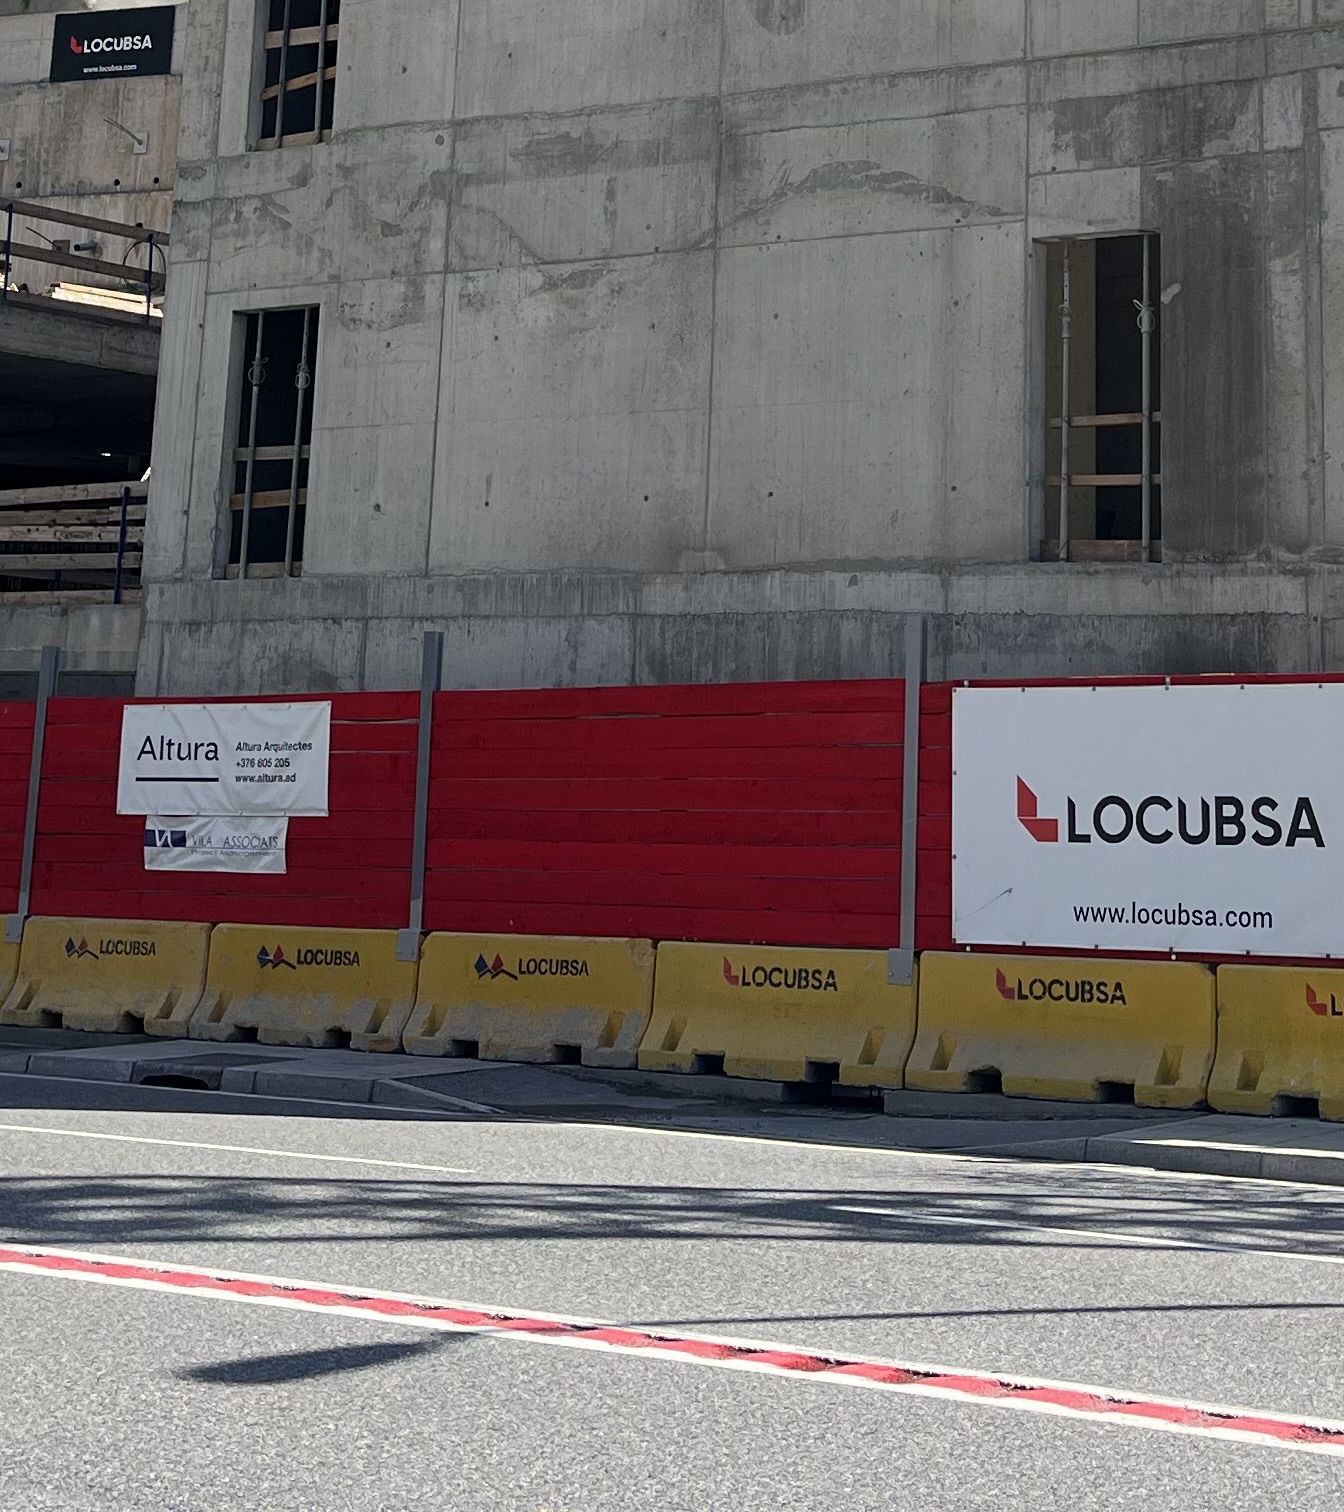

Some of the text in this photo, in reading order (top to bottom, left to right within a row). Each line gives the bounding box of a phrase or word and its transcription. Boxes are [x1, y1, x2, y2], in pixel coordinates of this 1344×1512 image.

[83, 34, 153, 53] LOCUBSA
[136, 735, 219, 761] Altura
[235, 741, 313, 753] Altura Arquitectes
[274, 758, 291, 768] 205
[1067, 795, 1326, 848] LOCUBSA
[1073, 901, 1273, 929] www.locubsa.com
[99, 939, 156, 956] LOCUBSA
[296, 949, 360, 968] LOCUBSA
[518, 957, 589, 977] LOCUBSA
[741, 965, 838, 992] LOCUBSA
[1016, 977, 1127, 1006] LOCUBSA
